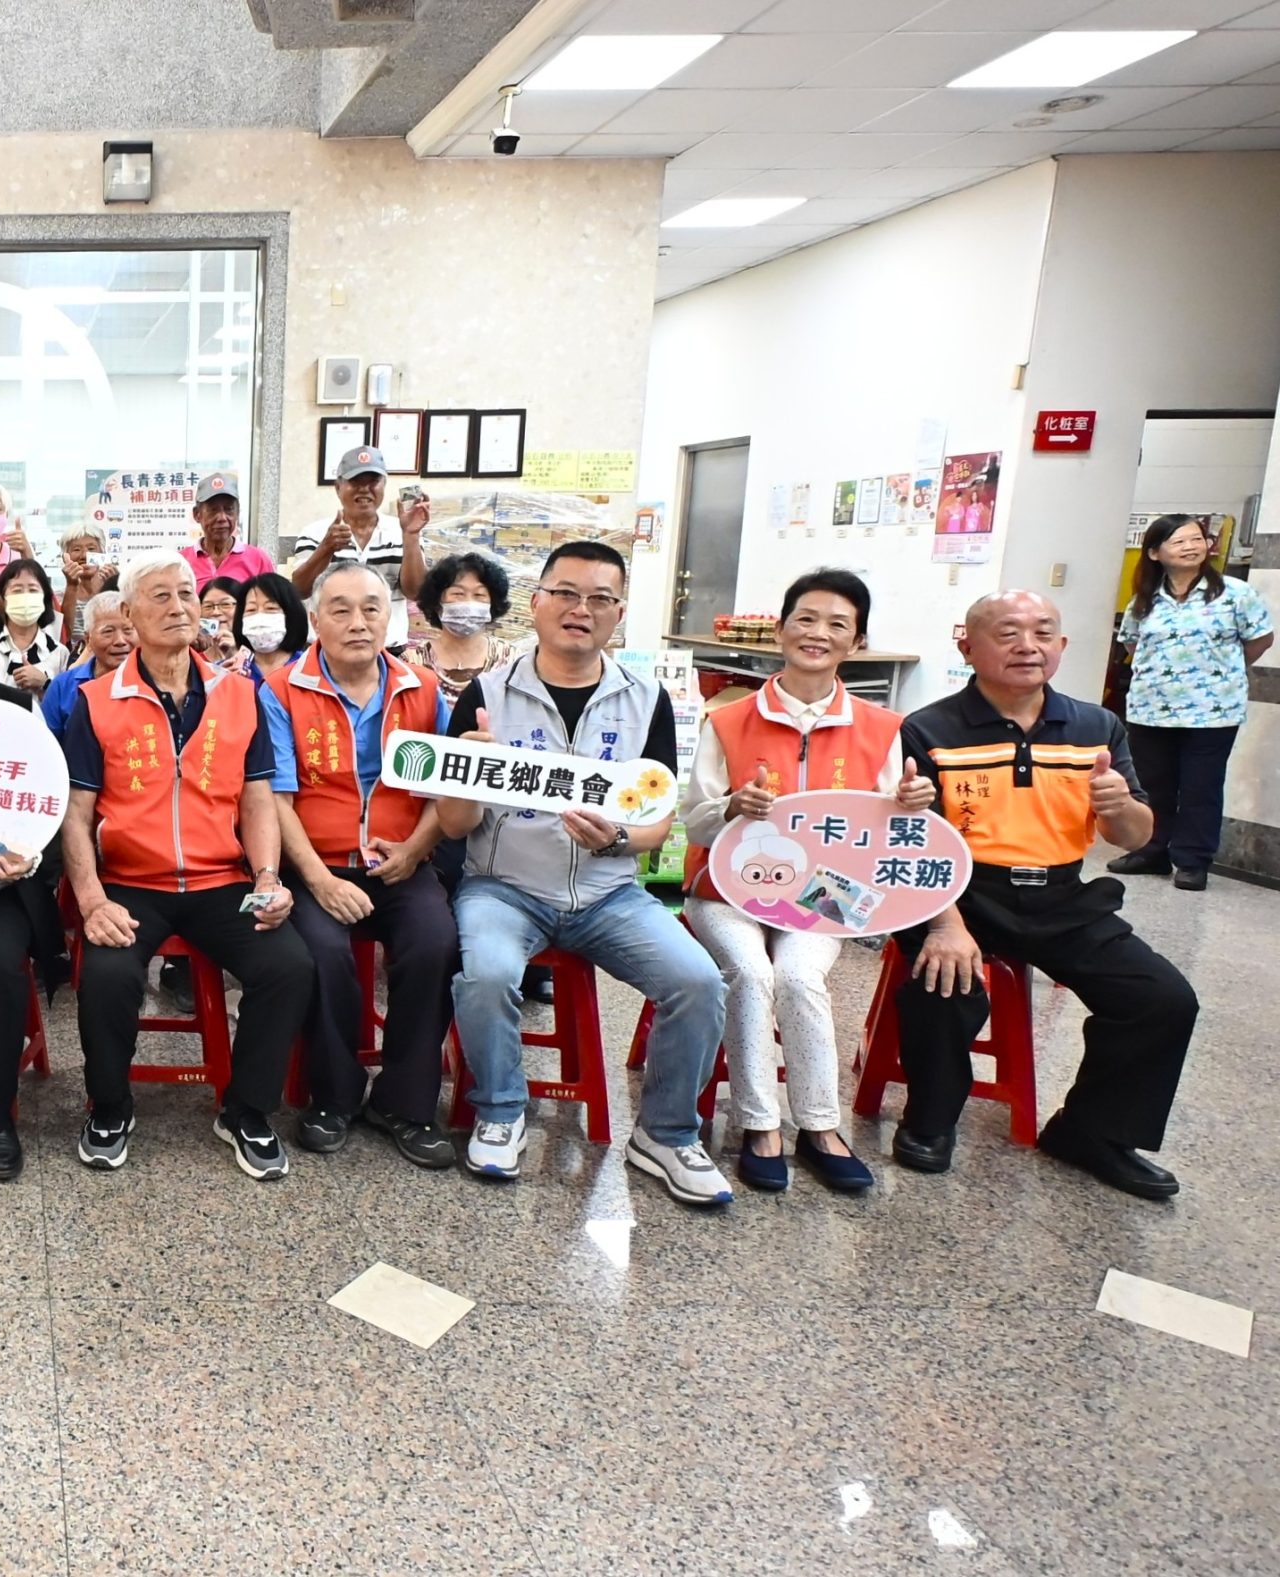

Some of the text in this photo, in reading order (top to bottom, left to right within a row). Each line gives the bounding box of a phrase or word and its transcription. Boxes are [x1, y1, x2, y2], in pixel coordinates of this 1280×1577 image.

[1044, 416, 1089, 431] 化粧室
[121, 472, 200, 489] 長青幸福卡
[130, 489, 194, 503] 補助項目
[200, 719, 216, 791] 田尾鄉老人會
[440, 752, 613, 806] 田尾鄉農會
[976, 774, 991, 798] 助理
[791, 815, 927, 848] 「卡」緊
[875, 857, 953, 888] 來辦
